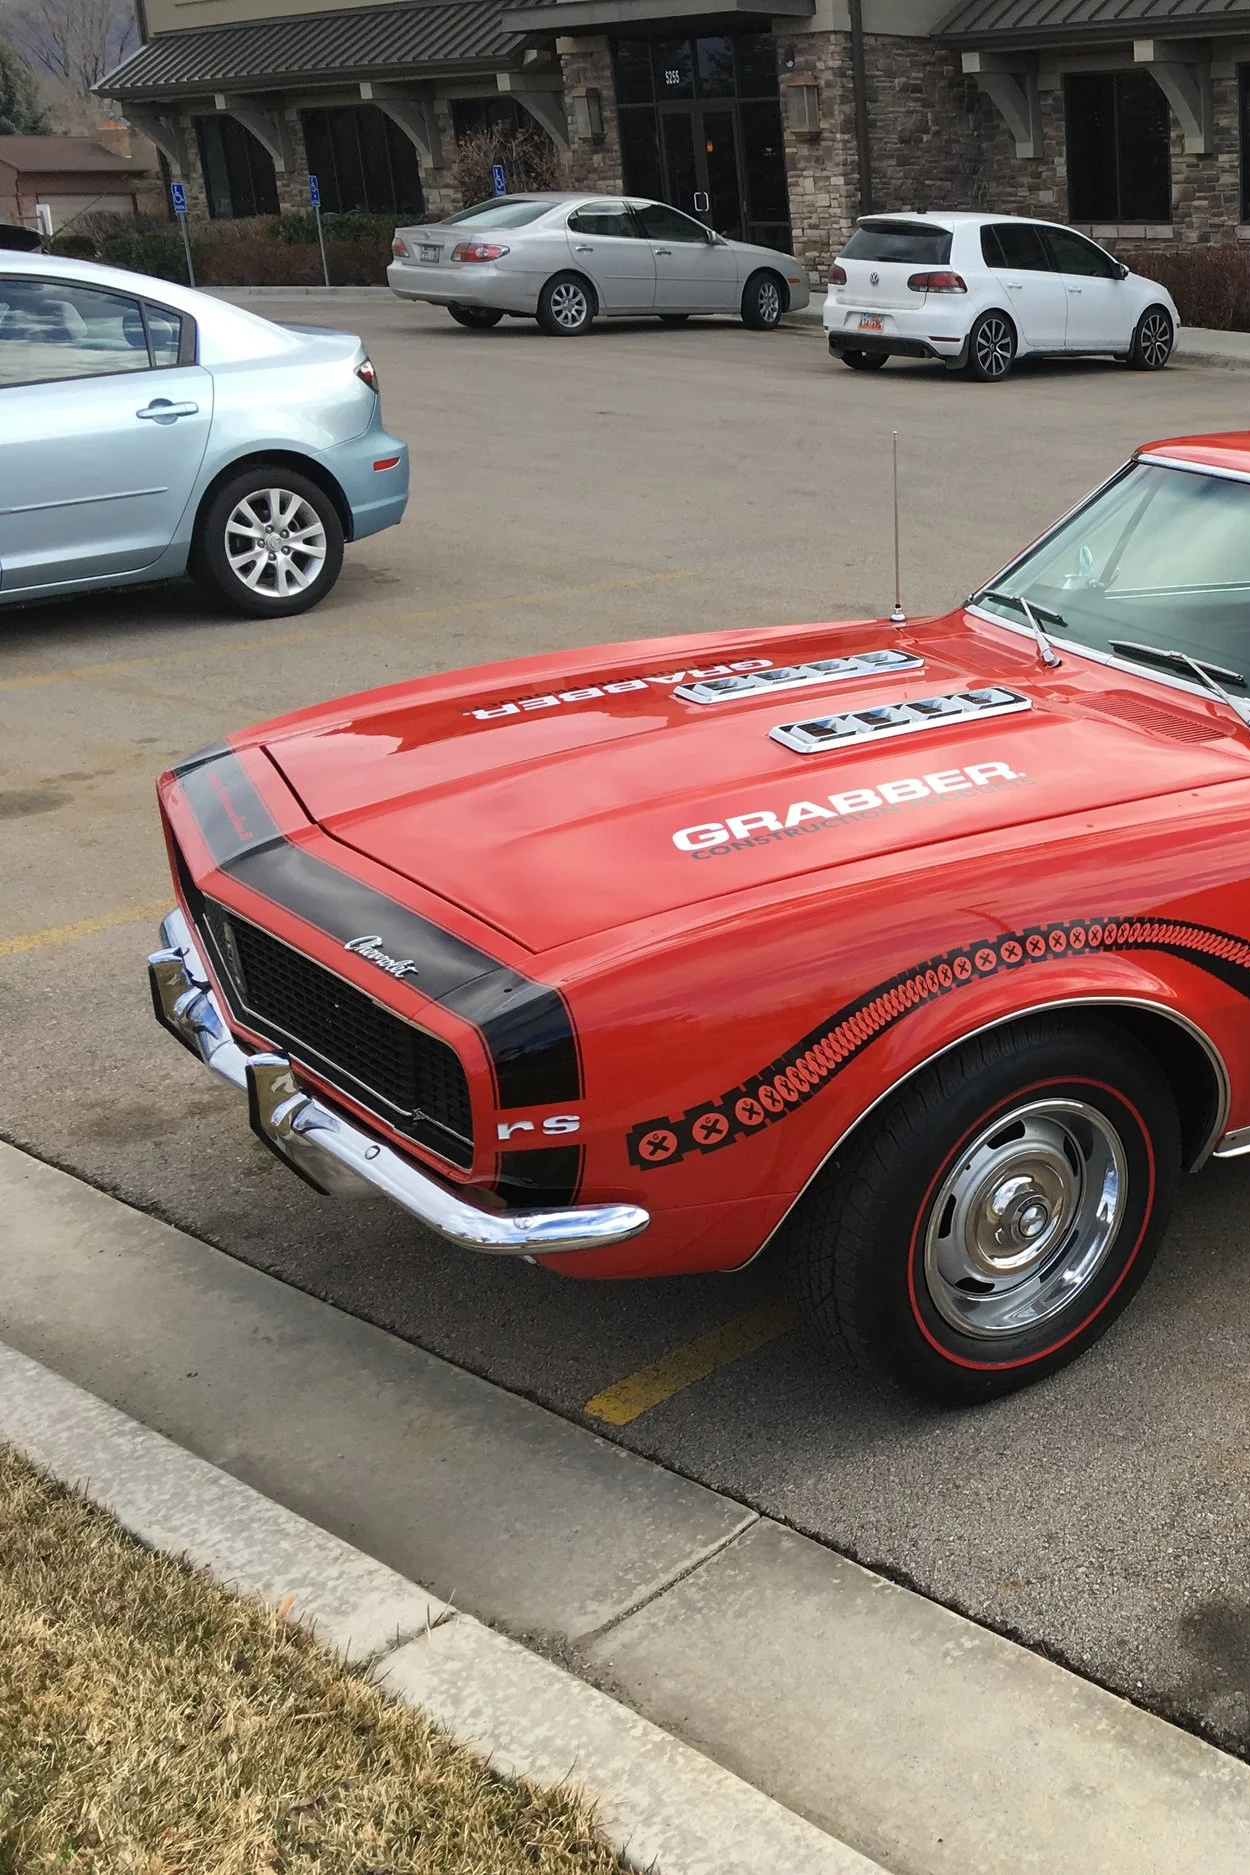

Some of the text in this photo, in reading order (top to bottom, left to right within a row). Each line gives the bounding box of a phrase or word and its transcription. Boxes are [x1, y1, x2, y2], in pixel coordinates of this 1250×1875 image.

[665, 69, 680, 84] 5255
[471, 659, 774, 720] GRABBER
[671, 761, 1020, 851] GRABBER
[691, 777, 1036, 860] CONSTRUCTION PRODUCTS
[344, 935, 419, 978] Chevrolet
[497, 1114, 581, 1140] rs
